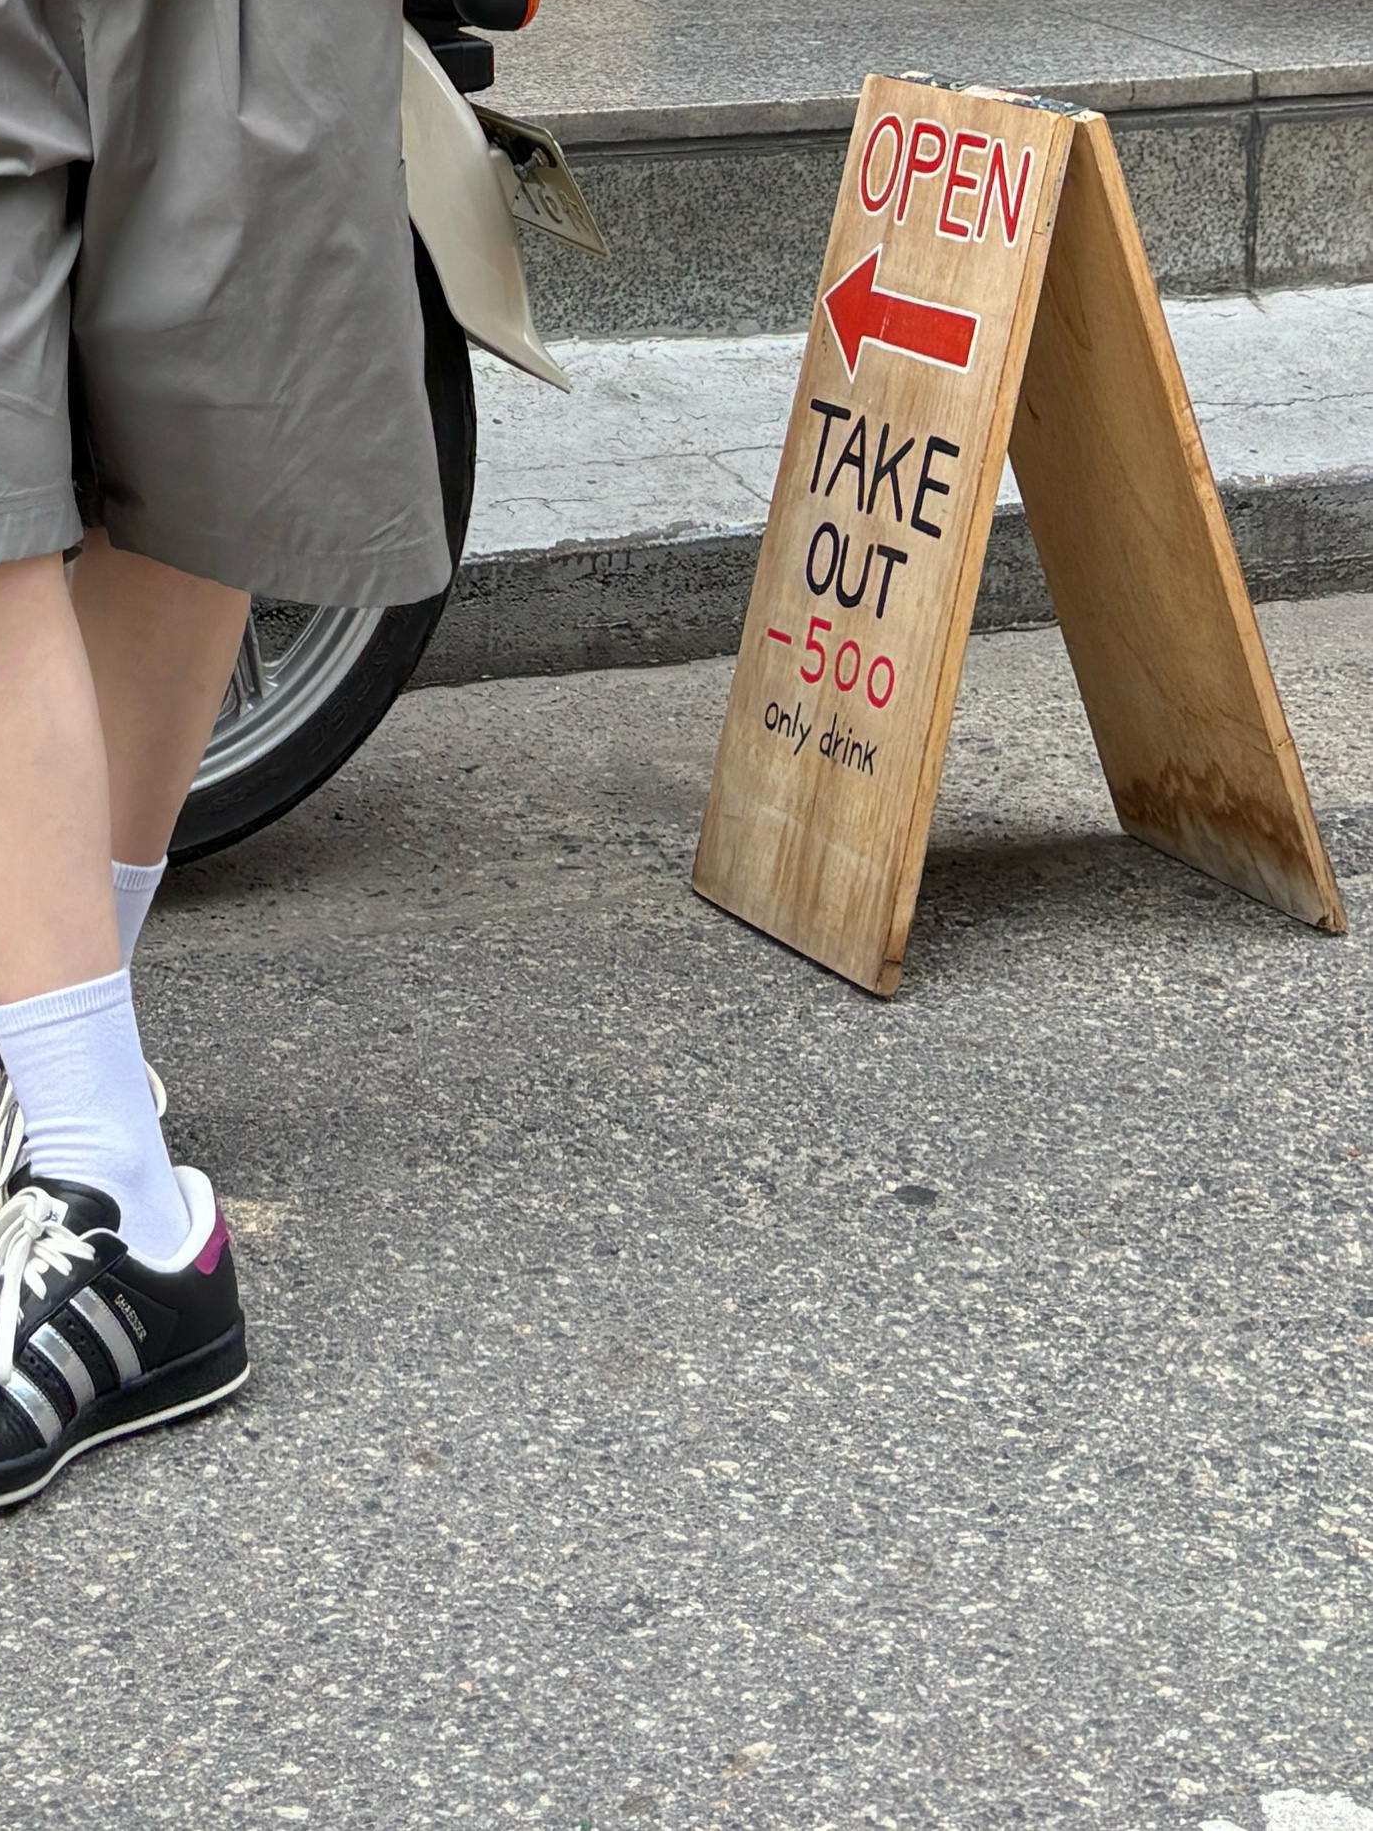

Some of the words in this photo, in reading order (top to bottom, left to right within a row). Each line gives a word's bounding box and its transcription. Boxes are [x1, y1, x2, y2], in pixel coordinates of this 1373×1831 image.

[858, 112, 1035, 248] OPEN
[810, 398, 960, 540] TAKE
[806, 521, 908, 619] OUT
[764, 701, 812, 756] only
[819, 712, 877, 776] drink
